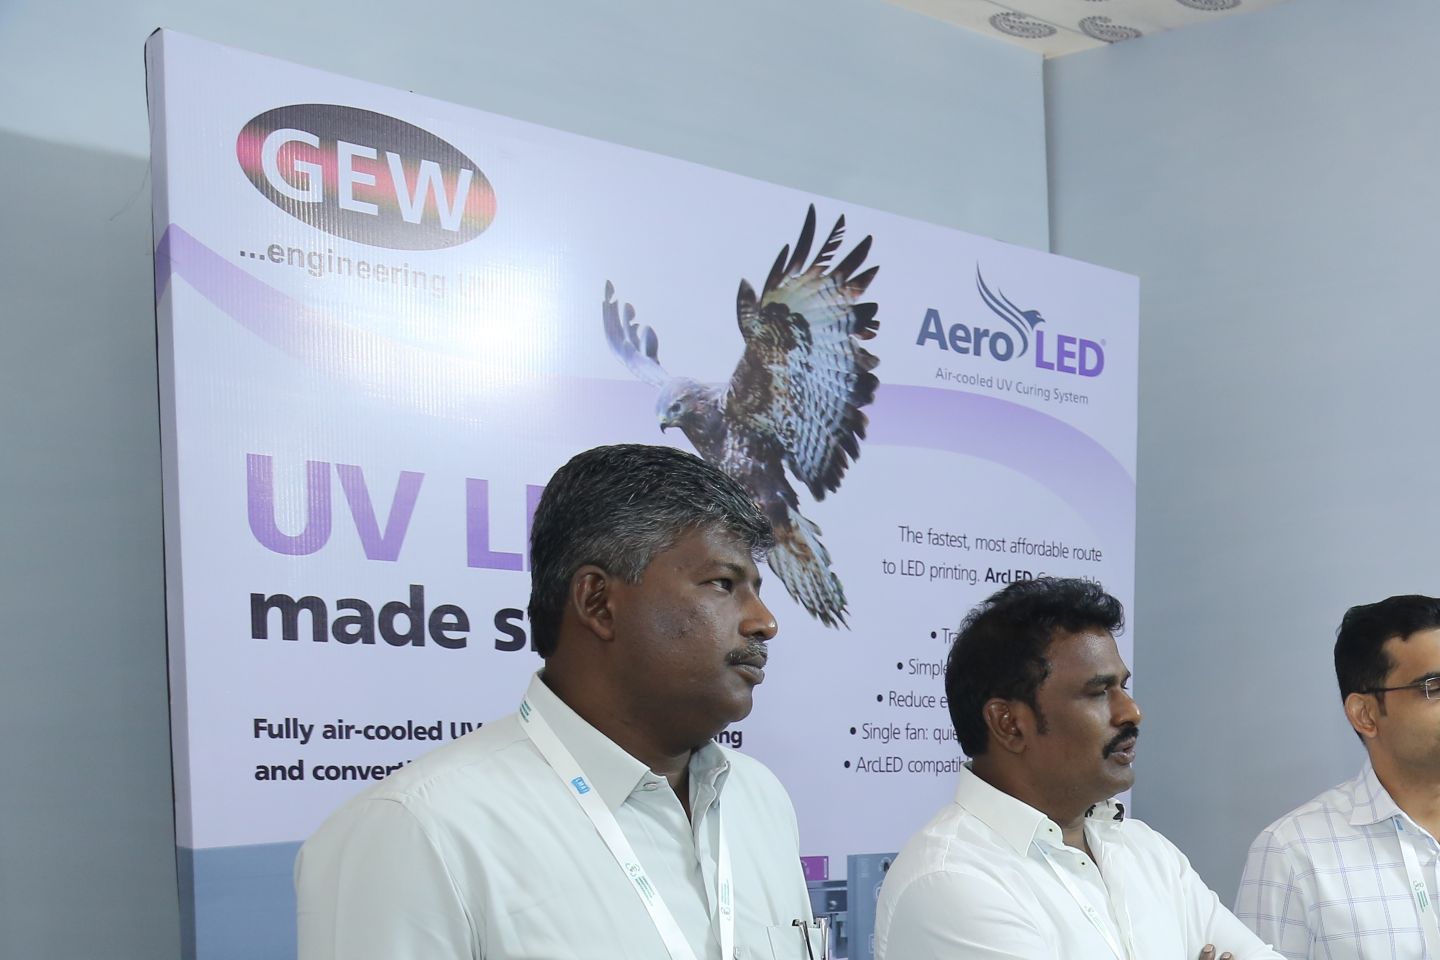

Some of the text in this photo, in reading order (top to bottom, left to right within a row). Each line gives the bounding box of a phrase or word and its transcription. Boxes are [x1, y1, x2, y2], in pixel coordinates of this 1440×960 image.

[261, 128, 474, 232] GEW
[916, 308, 1015, 362] Aero
[935, 367, 1089, 405] Air-cooled UV Curing System
[246, 453, 425, 562] UV
[898, 525, 1102, 562] The fastest, most affordable route
[882, 558, 896, 575] to
[900, 559, 925, 577] LED
[929, 563, 981, 586] printing.
[249, 584, 540, 653] made s
[888, 691, 936, 708] Reduce
[253, 718, 314, 745] Fully
[322, 719, 443, 741] air-cooled
[862, 723, 900, 744] Single
[904, 724, 929, 741] fan:
[254, 759, 413, 781] and conver
[855, 756, 970, 776] ArcLED compati
